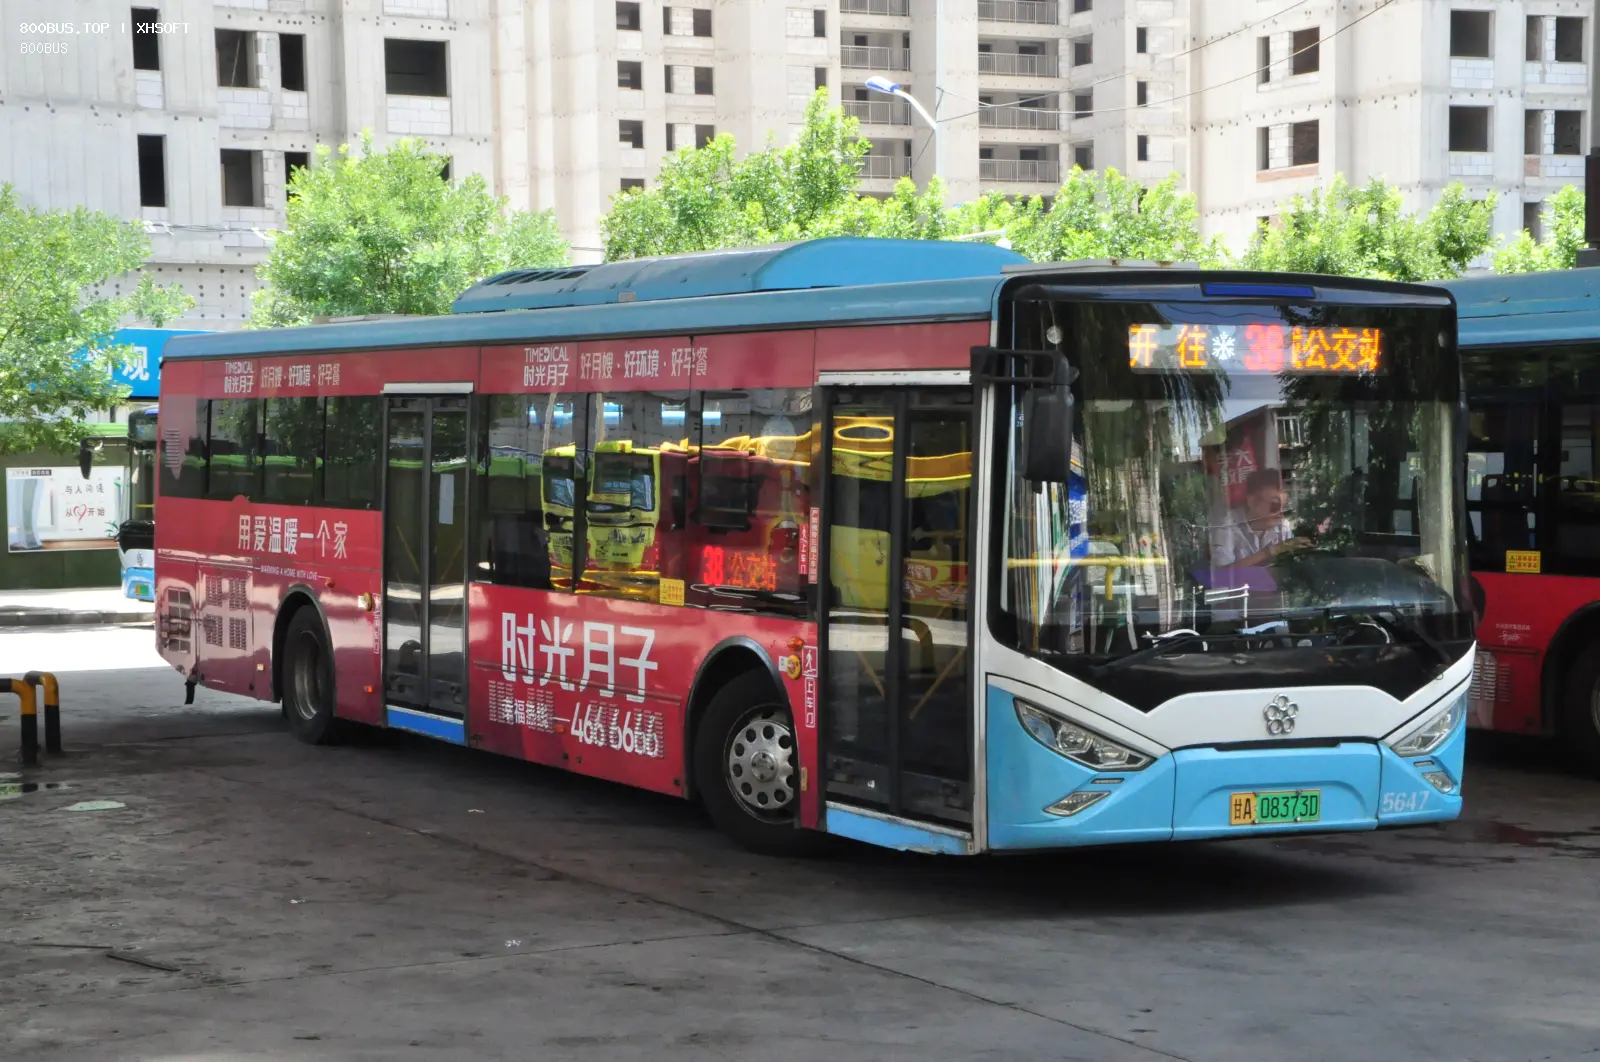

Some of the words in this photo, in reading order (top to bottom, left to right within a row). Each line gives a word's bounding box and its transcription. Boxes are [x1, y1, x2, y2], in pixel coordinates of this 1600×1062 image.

[523, 345, 570, 363] TIMEDICAL
[224, 375, 254, 393] 时光月子
[523, 364, 569, 387] 时光月子
[237, 514, 348, 559] 用爱温暖一个家
[306, 571, 318, 581] LOVE
[703, 544, 724, 587] 38
[501, 611, 659, 704] 时光月子
[1383, 790, 1431, 813] 5647
